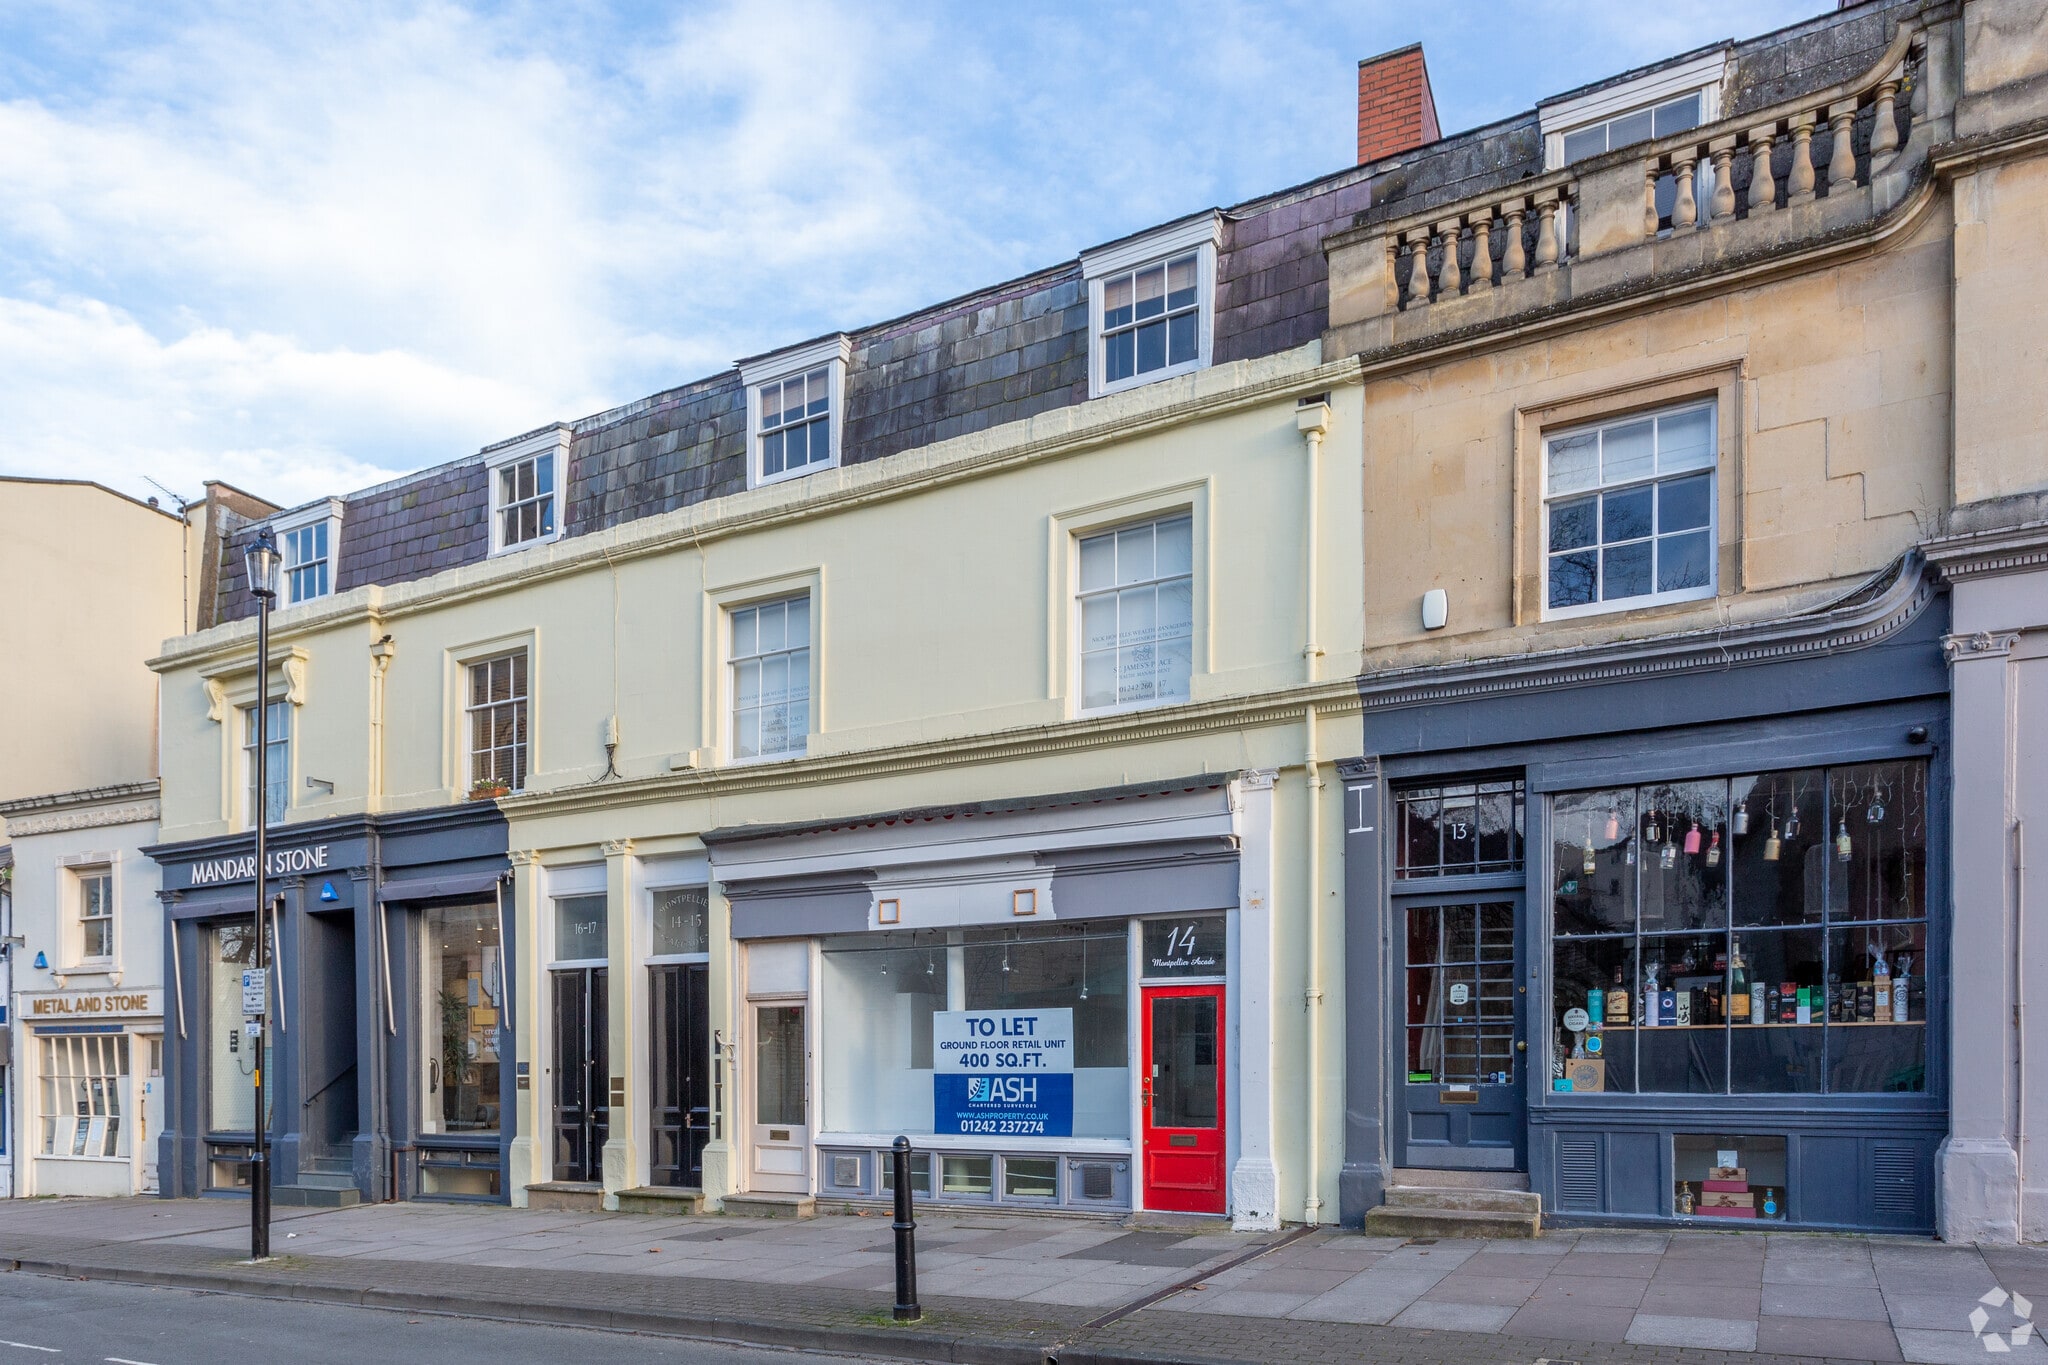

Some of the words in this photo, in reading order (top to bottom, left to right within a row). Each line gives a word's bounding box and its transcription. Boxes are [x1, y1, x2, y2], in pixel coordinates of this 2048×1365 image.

[1151, 659, 1173, 668] PACE
[1451, 823, 1467, 840] 13
[191, 853, 271, 884] MANDARN
[275, 845, 328, 874] STONE
[660, 893, 709, 912] MONTPELLIE
[575, 921, 597, 935] 16-17
[672, 913, 702, 928] 14-15
[1167, 925, 1196, 956] 14
[1151, 957, 1189, 969] Montpellier
[1190, 956, 1216, 966] Arcade
[33, 998, 72, 1014] METAL
[75, 997, 102, 1012] AND
[105, 995, 148, 1011] STONE
[966, 1018, 996, 1037] TO
[1002, 1017, 1038, 1036] LET
[940, 1041, 978, 1050] GROUND
[980, 1040, 1009, 1049] FLOOR
[1012, 1040, 1041, 1049] RETAIL
[1044, 1039, 1066, 1048] UNIT
[959, 1053, 989, 1068] 400
[995, 1052, 1047, 1068] SQ.FT.
[145, 1083, 152, 1093] 2
[990, 1077, 1037, 1103] ASH
[957, 1112, 1049, 1120] WWW.ASHPROPERTY.CO.UK
[960, 1120, 996, 1132] 01242
[999, 1120, 1044, 1133] 237274
